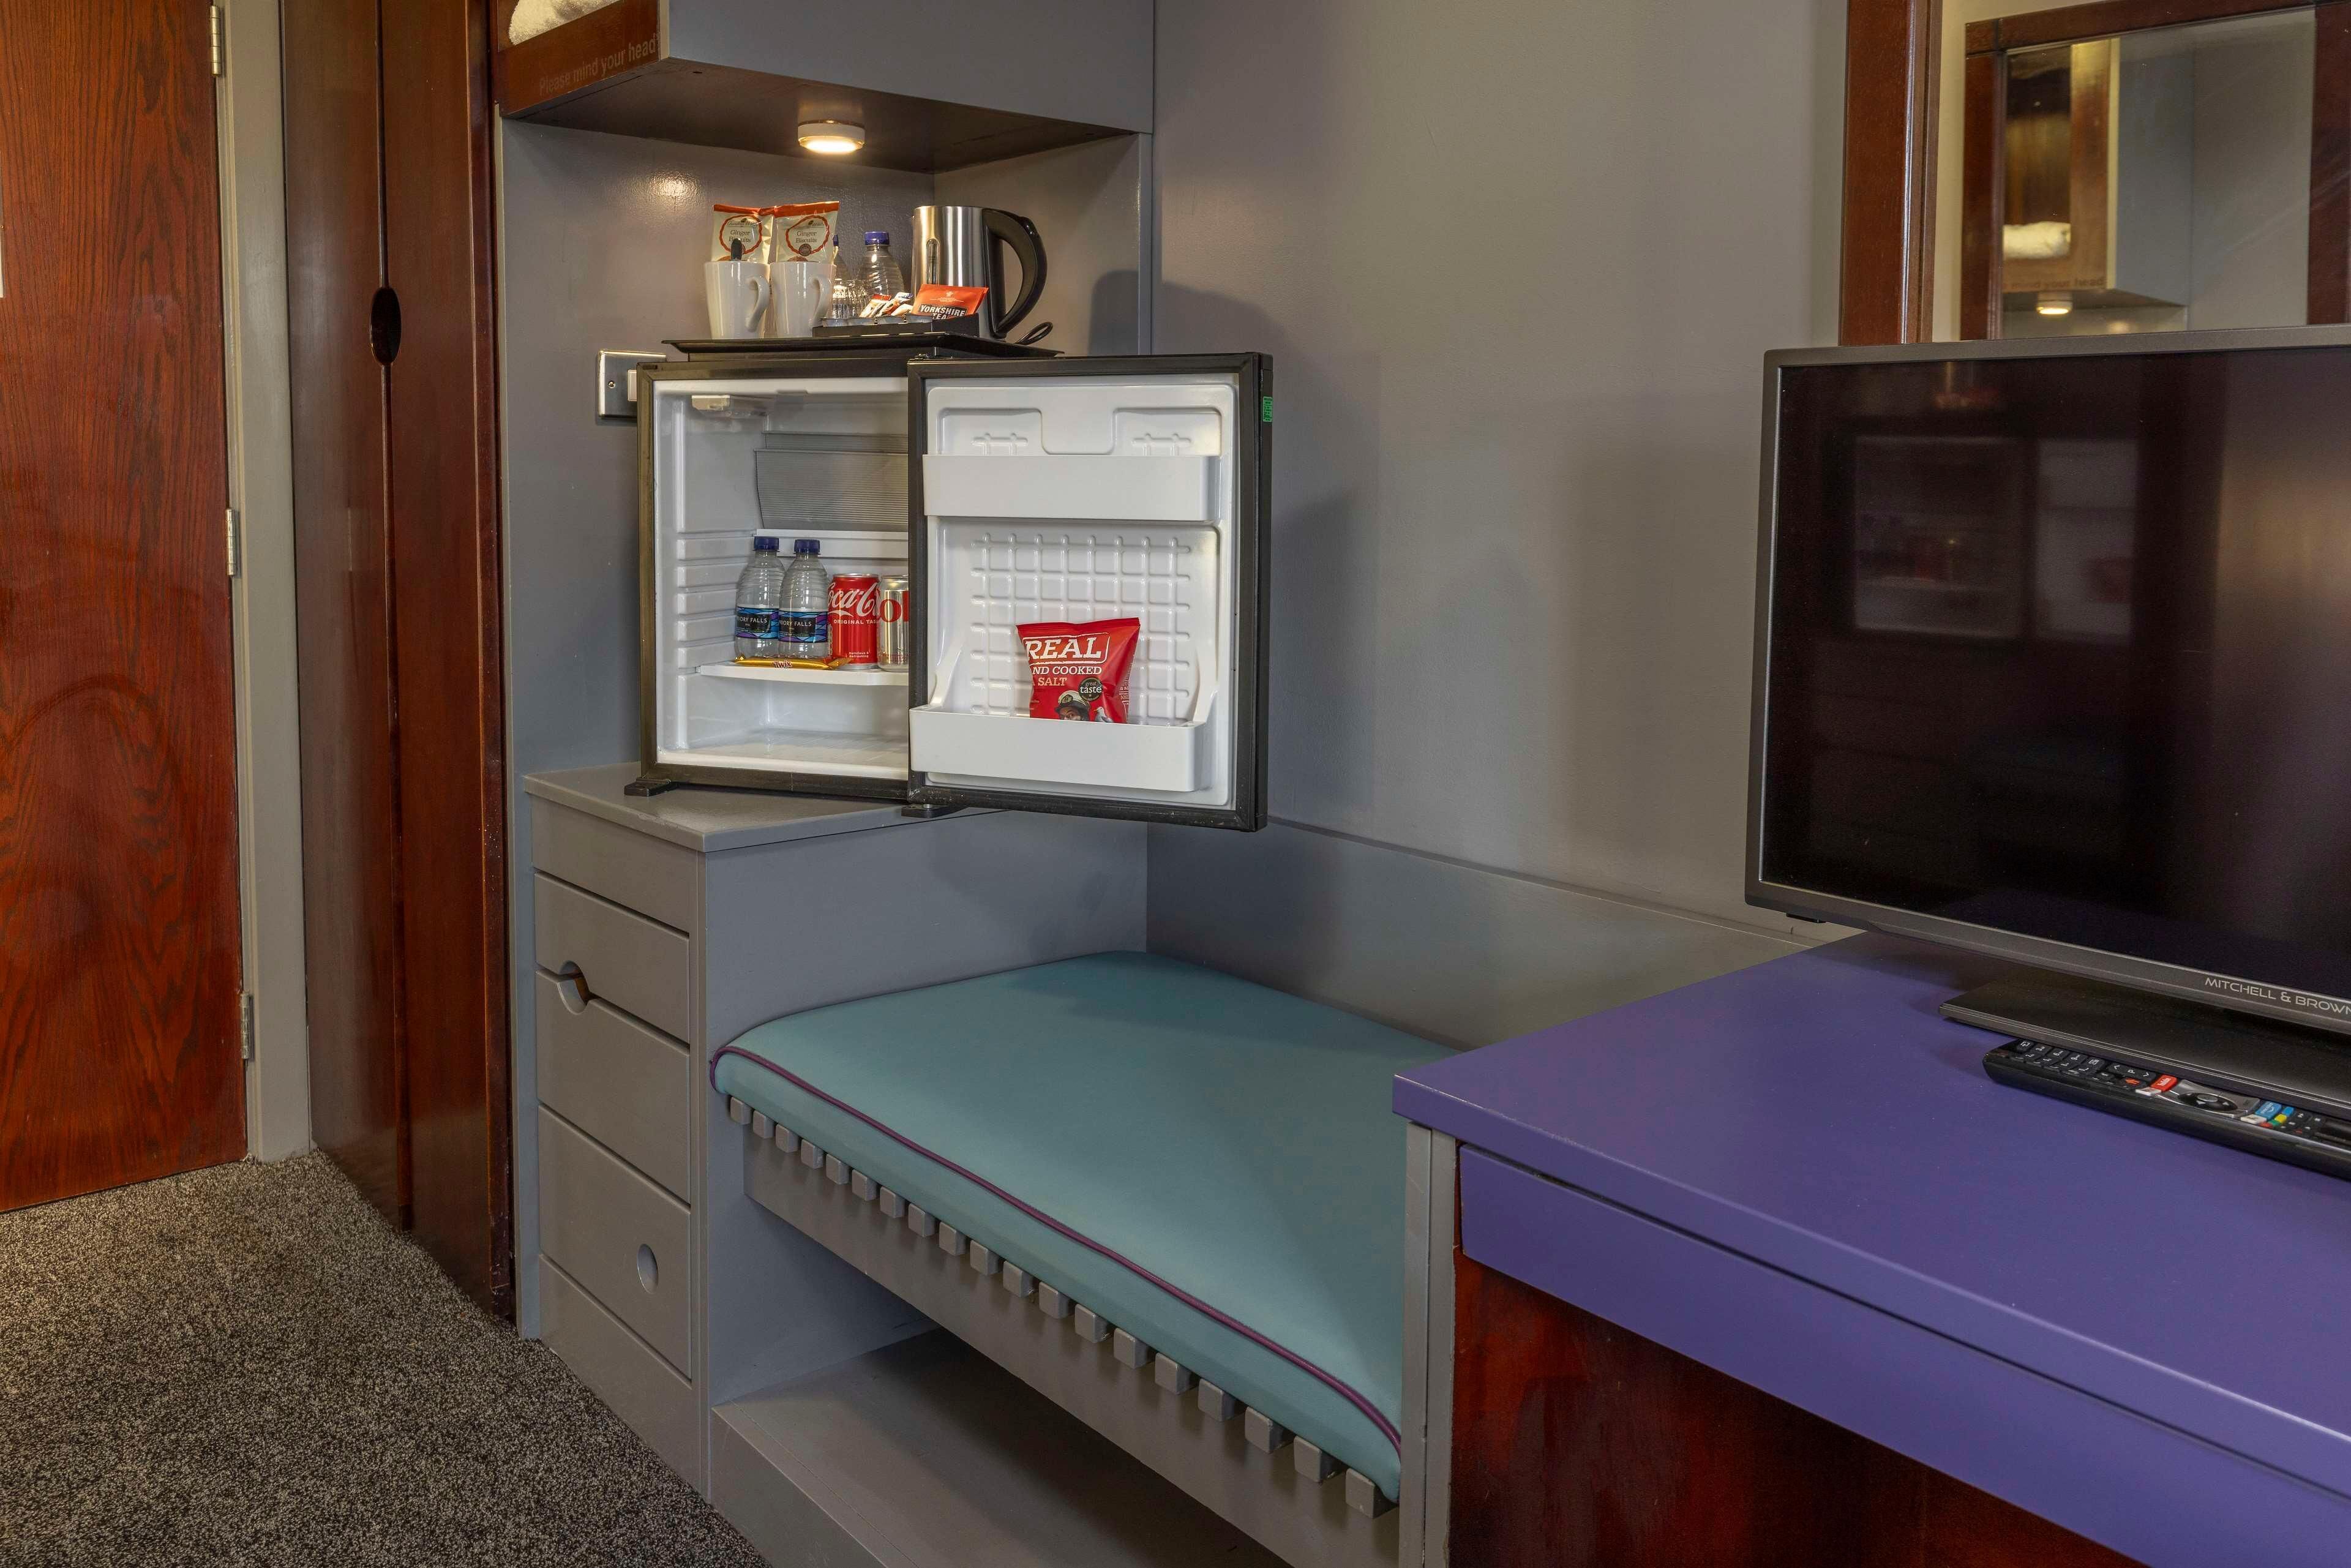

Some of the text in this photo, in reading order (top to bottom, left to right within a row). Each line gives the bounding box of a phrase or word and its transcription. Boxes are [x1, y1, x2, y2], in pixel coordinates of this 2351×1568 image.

[539, 33, 656, 96] Please mind your head
[920, 305, 966, 317] YORKSHIRE
[1026, 637, 1101, 660] REAL
[1033, 666, 1049, 675] ND
[1038, 677, 1067, 686] SALT
[2205, 978, 2276, 1000] MITCHELL
[2280, 991, 2291, 1003] &
